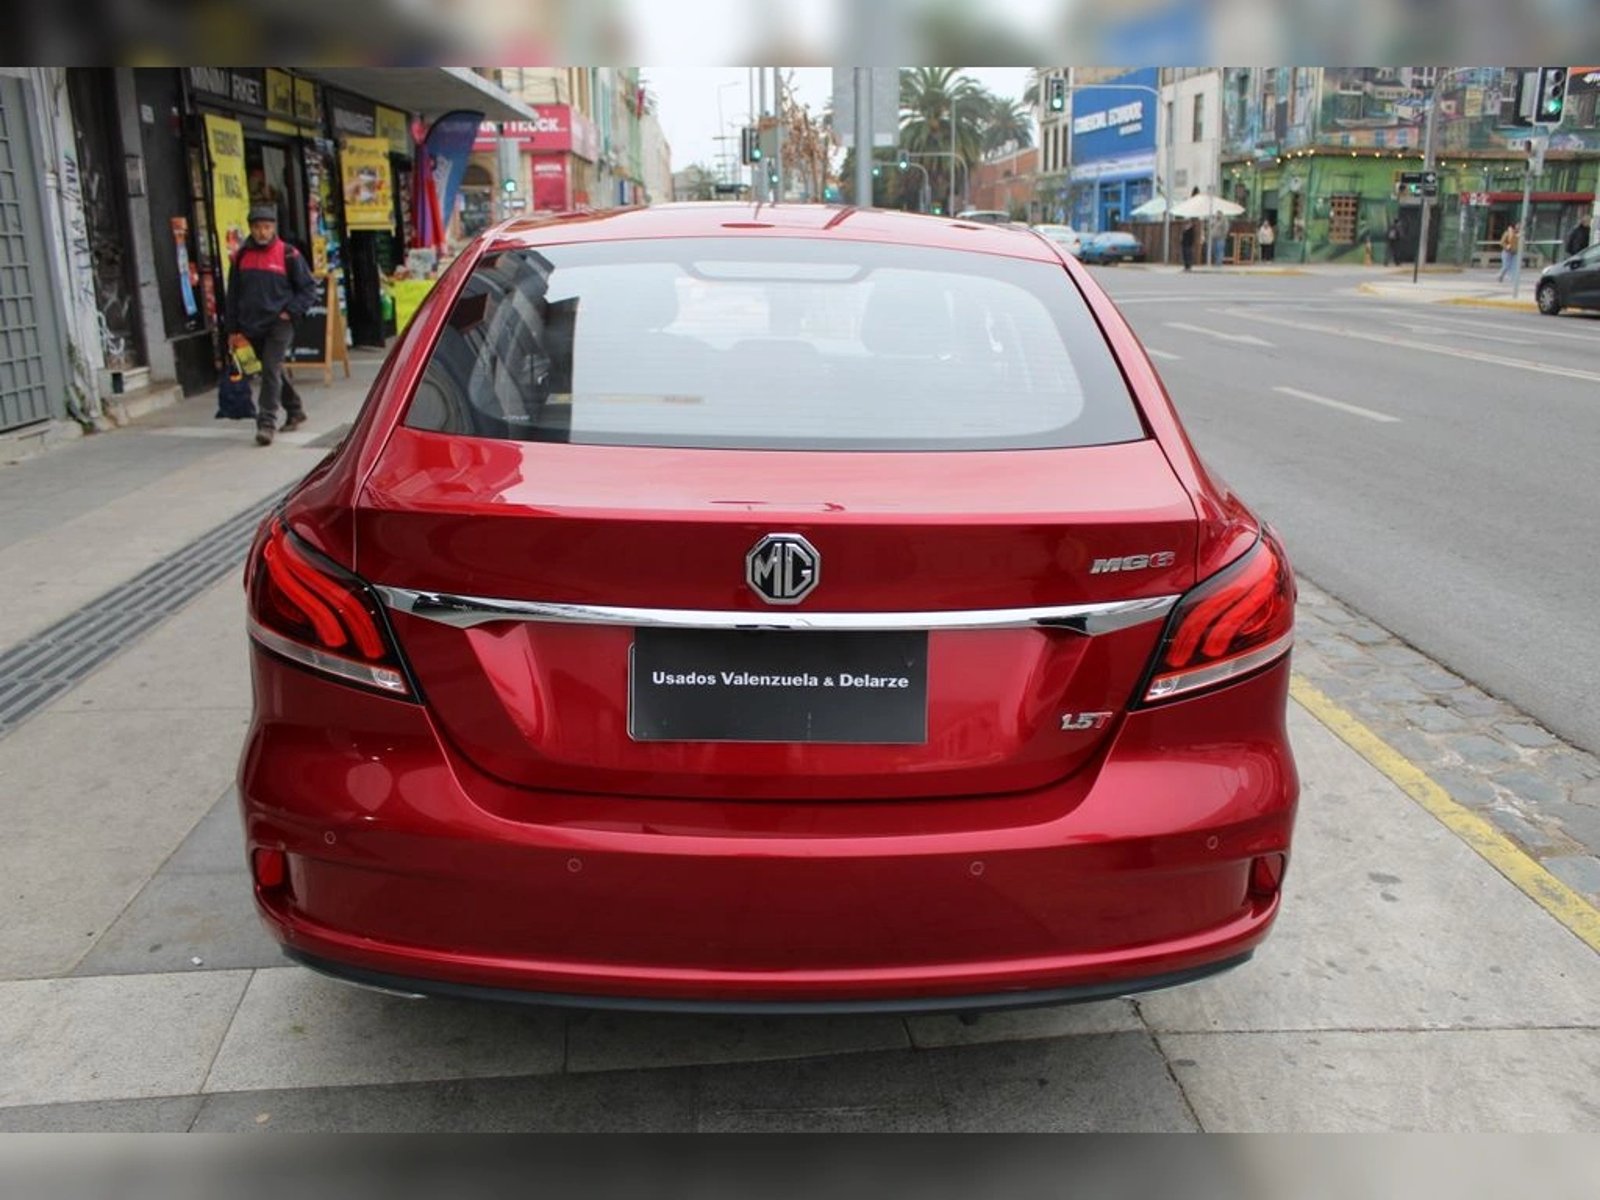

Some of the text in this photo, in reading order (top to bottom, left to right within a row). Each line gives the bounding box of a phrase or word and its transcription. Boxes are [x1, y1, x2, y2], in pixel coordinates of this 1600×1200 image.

[752, 541, 814, 599] MG
[652, 671, 909, 688] Usados Valenzuela & Delarze
